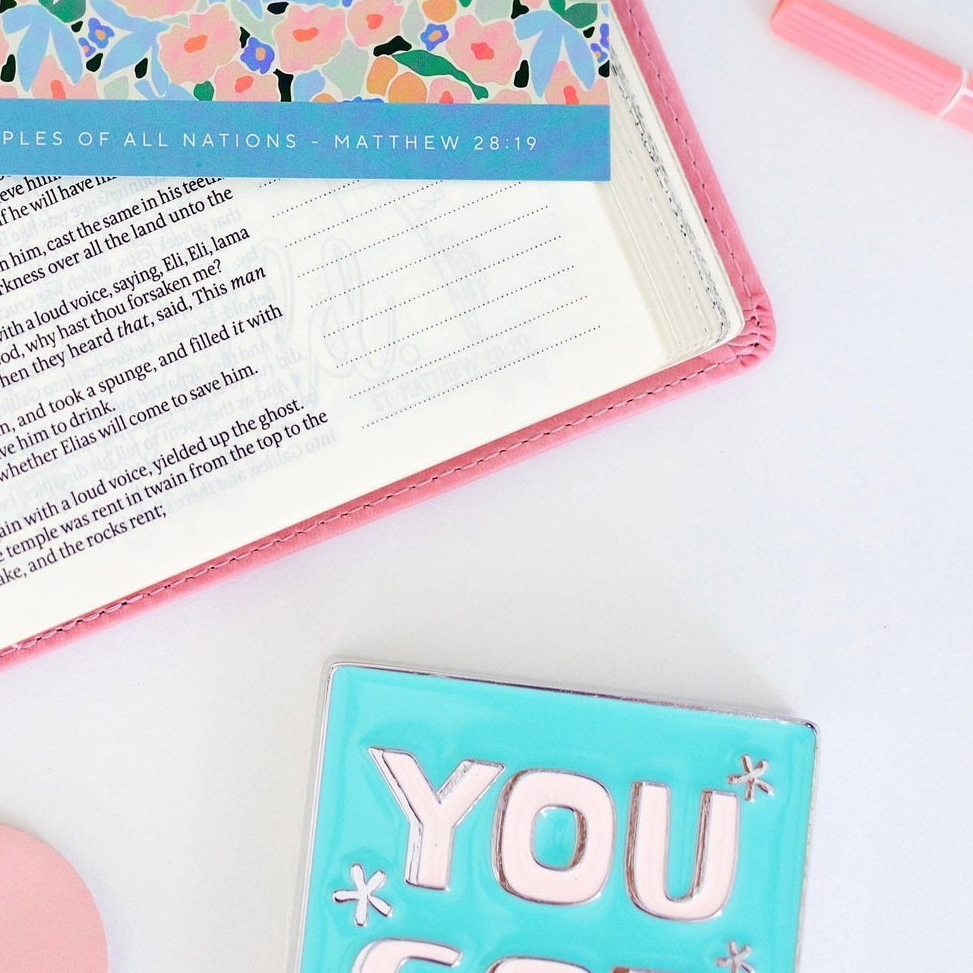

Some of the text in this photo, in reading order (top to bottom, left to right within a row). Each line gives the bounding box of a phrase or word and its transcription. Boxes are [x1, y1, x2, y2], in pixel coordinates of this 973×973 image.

[78, 132, 109, 146] OF
[124, 132, 168, 146] ALL
[184, 133, 295, 148] NATIONS
[335, 135, 458, 149] MATTHEW
[474, 136, 537, 151] 28:19
[47, 252, 80, 274] over
[83, 239, 104, 260] all
[104, 232, 131, 250] the
[130, 212, 168, 240] land
[168, 200, 205, 223] unto
[206, 188, 234, 207] the
[6, 526, 59, 558] temple
[59, 514, 90, 534] was
[91, 498, 125, 522] rent
[124, 492, 143, 507] in
[143, 472, 189, 498] twain
[189, 455, 229, 479] from
[229, 443, 256, 462] the
[256, 431, 283, 450] top
[283, 424, 301, 438] to
[302, 412, 328, 431] the
[367, 746, 741, 923] YOU
